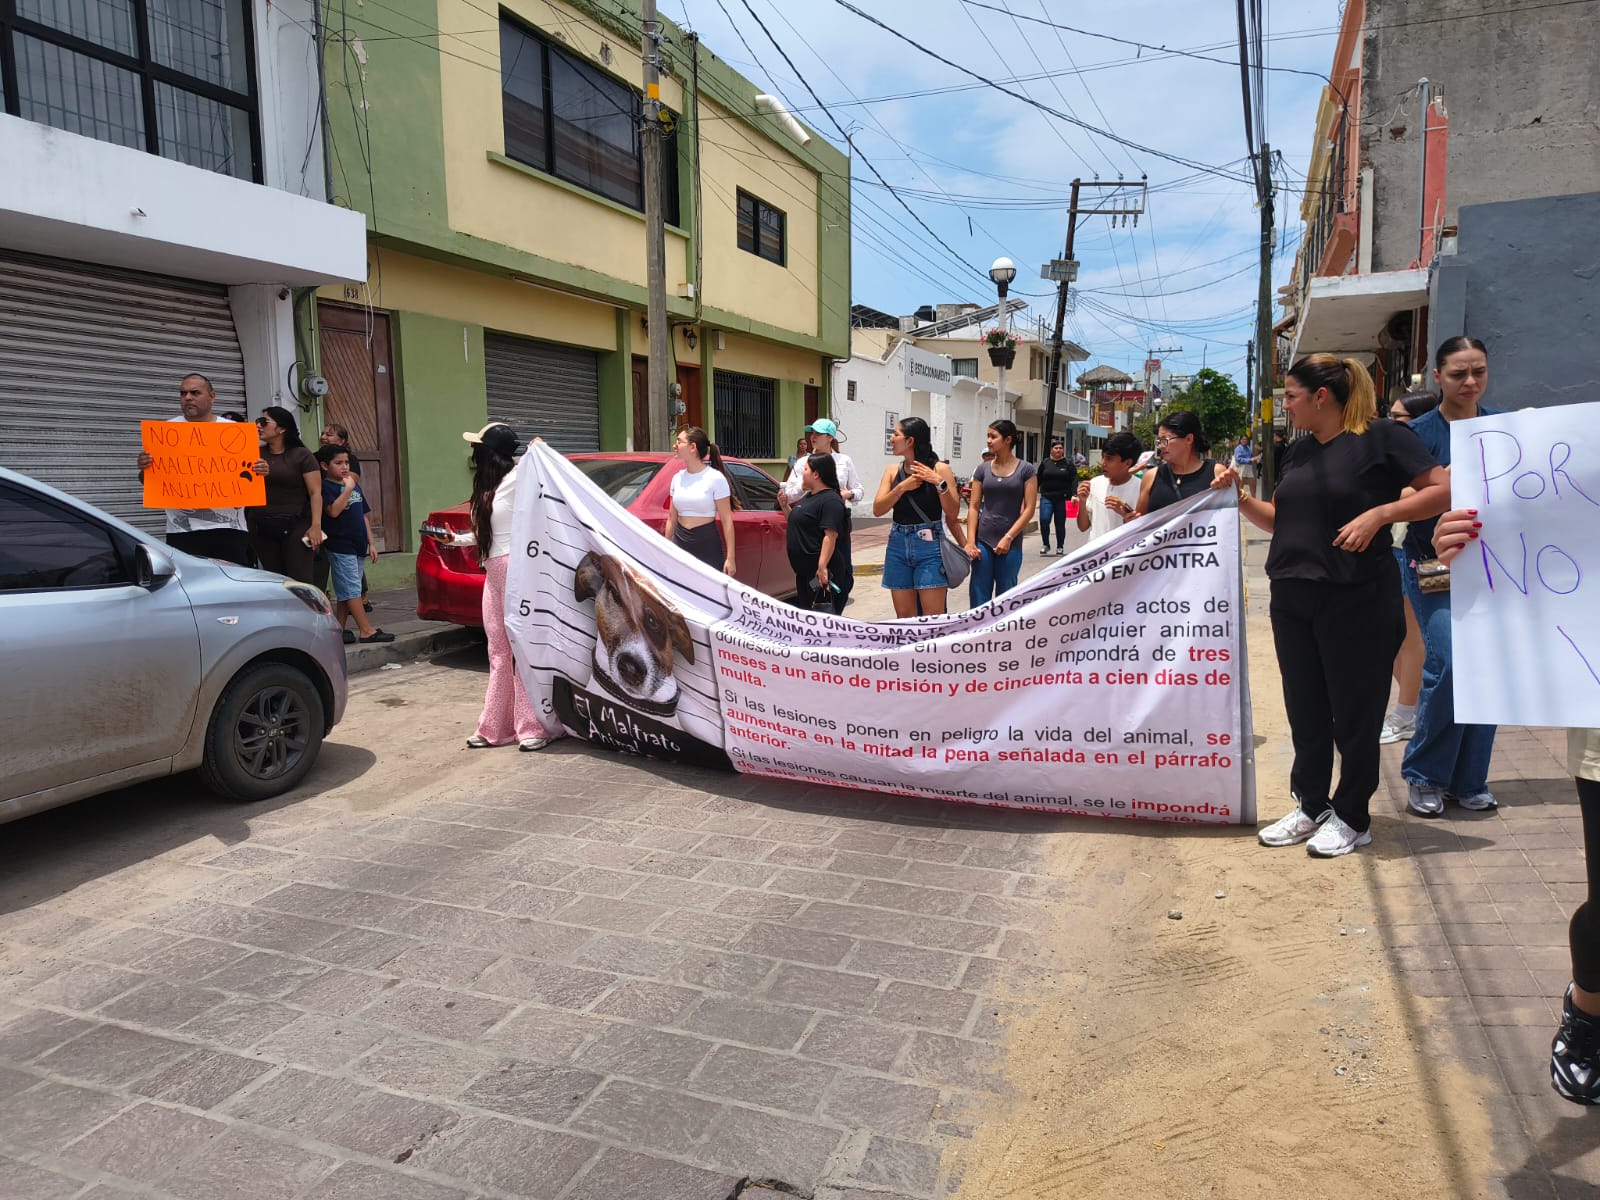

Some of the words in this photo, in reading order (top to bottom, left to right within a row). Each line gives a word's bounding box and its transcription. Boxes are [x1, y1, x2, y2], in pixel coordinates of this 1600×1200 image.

[150, 426, 179, 447] NO
[189, 426, 208, 447] AL
[151, 456, 238, 475] MALTRATO
[526, 540, 540, 558] 6
[1152, 523, 1217, 546] Sinaloa
[1111, 563, 1135, 580] EN
[1139, 552, 1219, 572] CONTRA
[1480, 532, 1581, 595] NO
[519, 600, 531, 616] 5
[743, 605, 762, 621] DE
[765, 615, 850, 639] ANIMALES
[1048, 601, 1124, 627] comenta
[1136, 598, 1191, 614] actos
[1203, 596, 1230, 613] de
[914, 642, 937, 653] en
[951, 638, 1012, 654] contra
[1025, 635, 1048, 650] de
[1060, 621, 1146, 644] cualquier
[1160, 620, 1230, 638] animal
[718, 648, 767, 671] meses
[771, 665, 781, 675] a
[785, 666, 806, 679] un
[811, 668, 844, 685] año
[848, 674, 871, 689] de
[876, 678, 943, 694] prisión
[948, 682, 960, 697] y
[965, 679, 988, 693] de
[993, 669, 1083, 692] cincuenta
[1088, 672, 1100, 685] a
[1105, 668, 1148, 685] cien
[1154, 668, 1199, 686] días
[1204, 669, 1231, 686] de
[800, 650, 900, 672] causandole
[911, 658, 987, 674] lesiones
[998, 660, 1020, 672] se
[1030, 654, 1046, 669] le
[1055, 645, 1140, 665] impondrá
[1152, 645, 1176, 662] de
[1188, 646, 1230, 662] tres
[720, 665, 767, 688] multa.
[574, 694, 592, 721] El
[601, 705, 681, 752] Maltrato
[724, 689, 737, 704] Si
[744, 696, 766, 713] las
[773, 703, 837, 730] lesiones
[846, 722, 899, 740] ponen
[909, 729, 931, 742] en
[941, 726, 999, 744] peligro
[1008, 725, 1024, 742] la
[1034, 726, 1073, 743] vida
[1083, 727, 1112, 744] del
[1123, 728, 1194, 747] animal,
[1206, 732, 1231, 747] se
[726, 707, 808, 740] aumentara
[813, 734, 835, 746] en
[840, 737, 856, 751] la
[863, 743, 914, 759] mitad
[921, 745, 937, 759] la
[945, 747, 990, 764] pena
[998, 746, 1086, 764] señalada
[1094, 752, 1119, 765] en
[1127, 750, 1145, 765] el
[1155, 751, 1232, 769] párrafo
[729, 723, 792, 751] anterior.
[731, 746, 745, 759] Si
[749, 751, 770, 765] las
[773, 757, 836, 778] lesiones
[839, 772, 897, 788] causan
[900, 782, 915, 792] la
[919, 787, 978, 799] muerte
[983, 791, 1009, 801] del
[1014, 793, 1078, 807] animal,
[1083, 798, 1105, 808] se
[1110, 797, 1126, 809] le
[1131, 798, 1231, 817] impondrá
